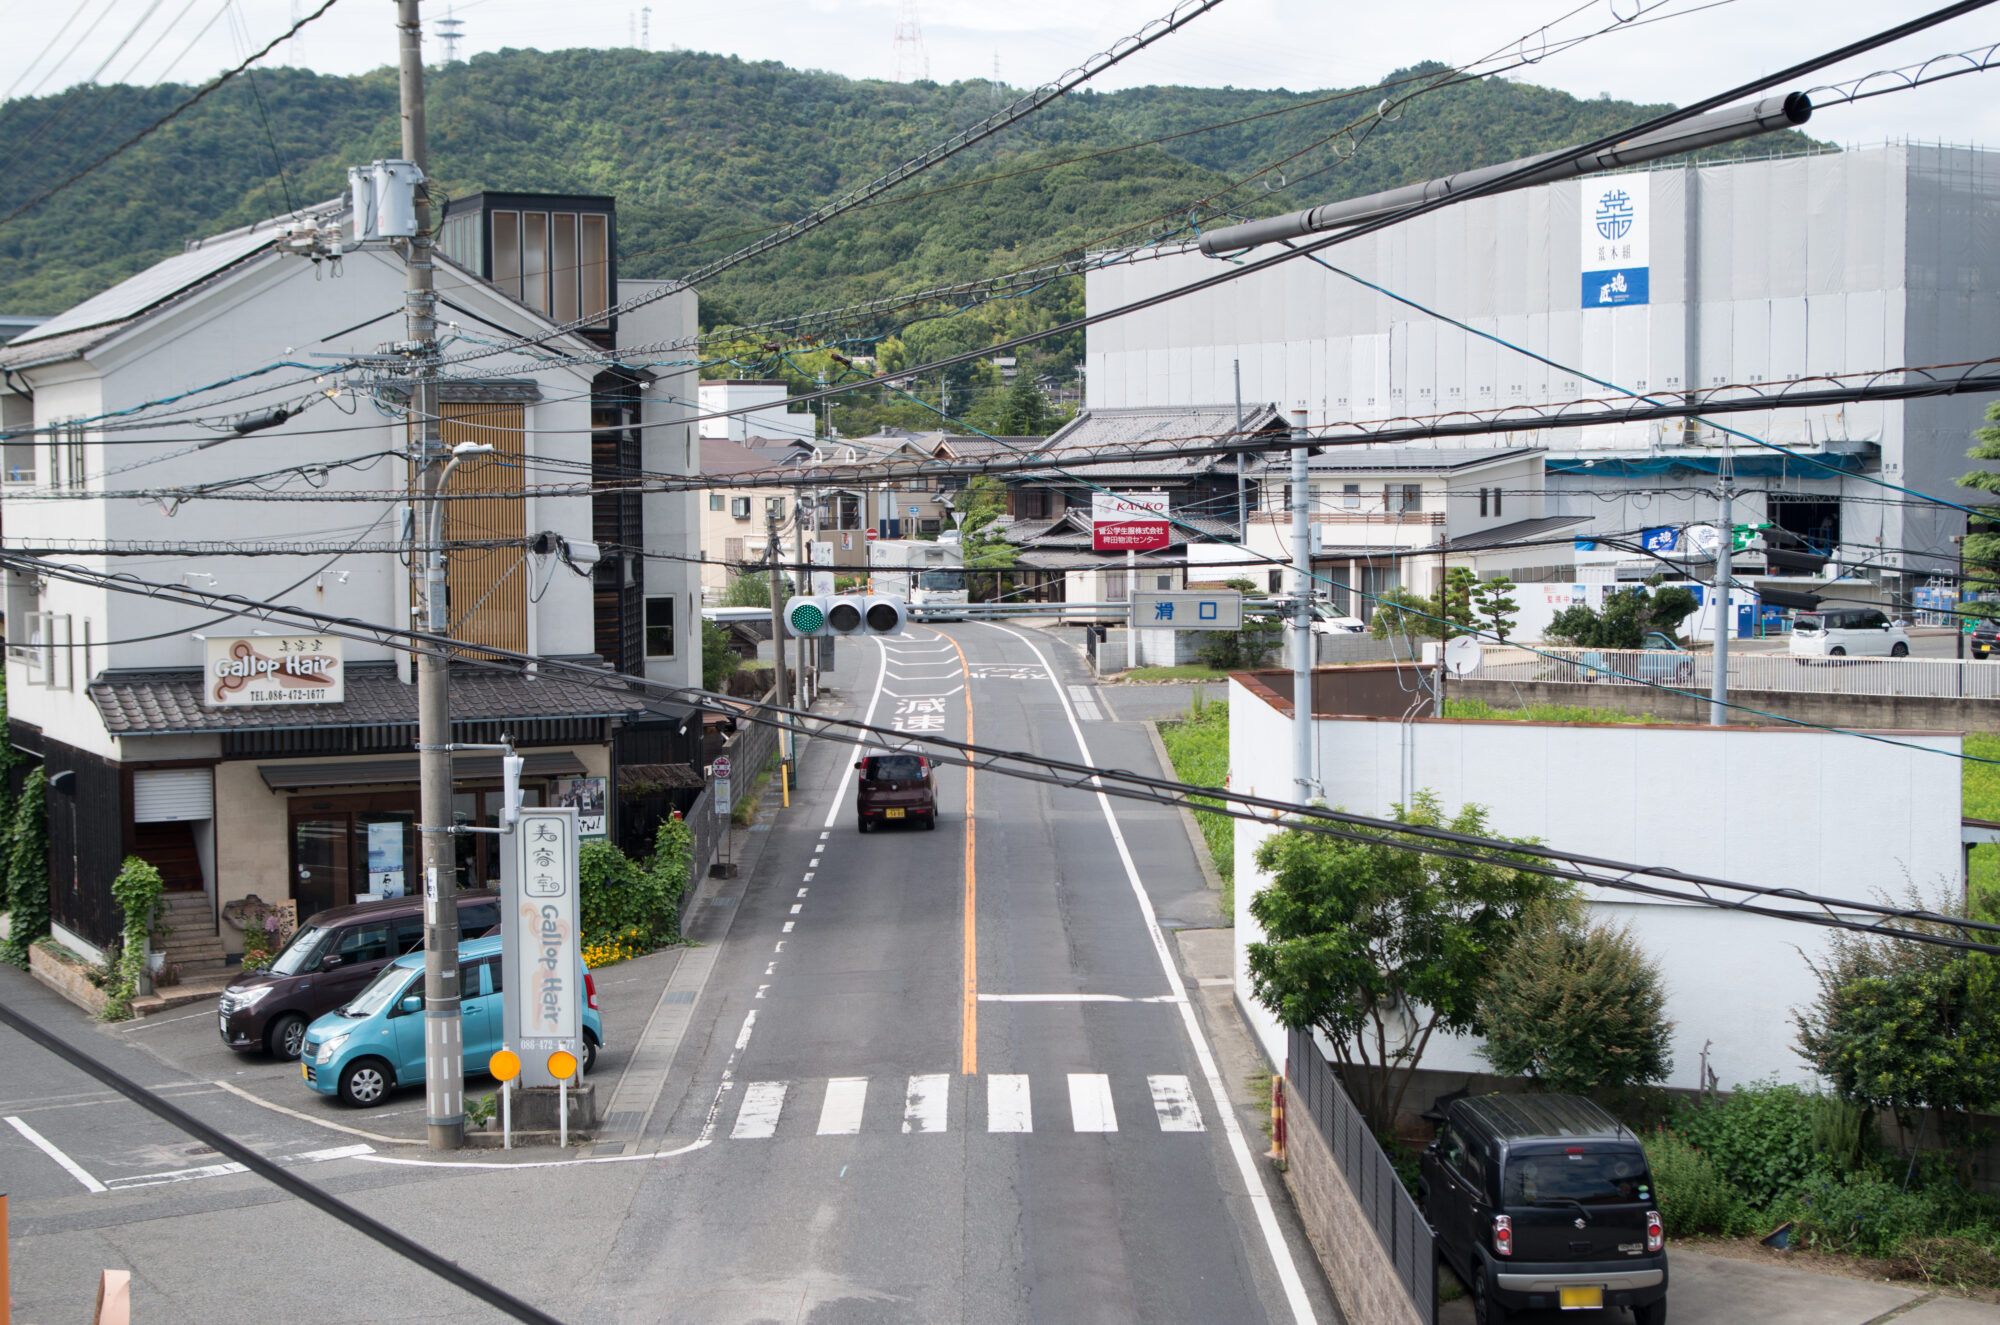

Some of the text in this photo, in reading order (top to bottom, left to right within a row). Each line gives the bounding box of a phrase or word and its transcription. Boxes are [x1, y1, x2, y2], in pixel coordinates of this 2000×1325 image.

[1116, 501, 1164, 512] KANKO
[1155, 601, 1217, 621] 滑口
[214, 654, 332, 681] Gallop Hair
[250, 689, 325, 702] TEL.086-472-1677
[891, 697, 946, 732] 減速
[531, 823, 560, 893] 美容室
[538, 904, 562, 1025] Gallop Hair
[520, 1039, 575, 1050] 086-472-177
